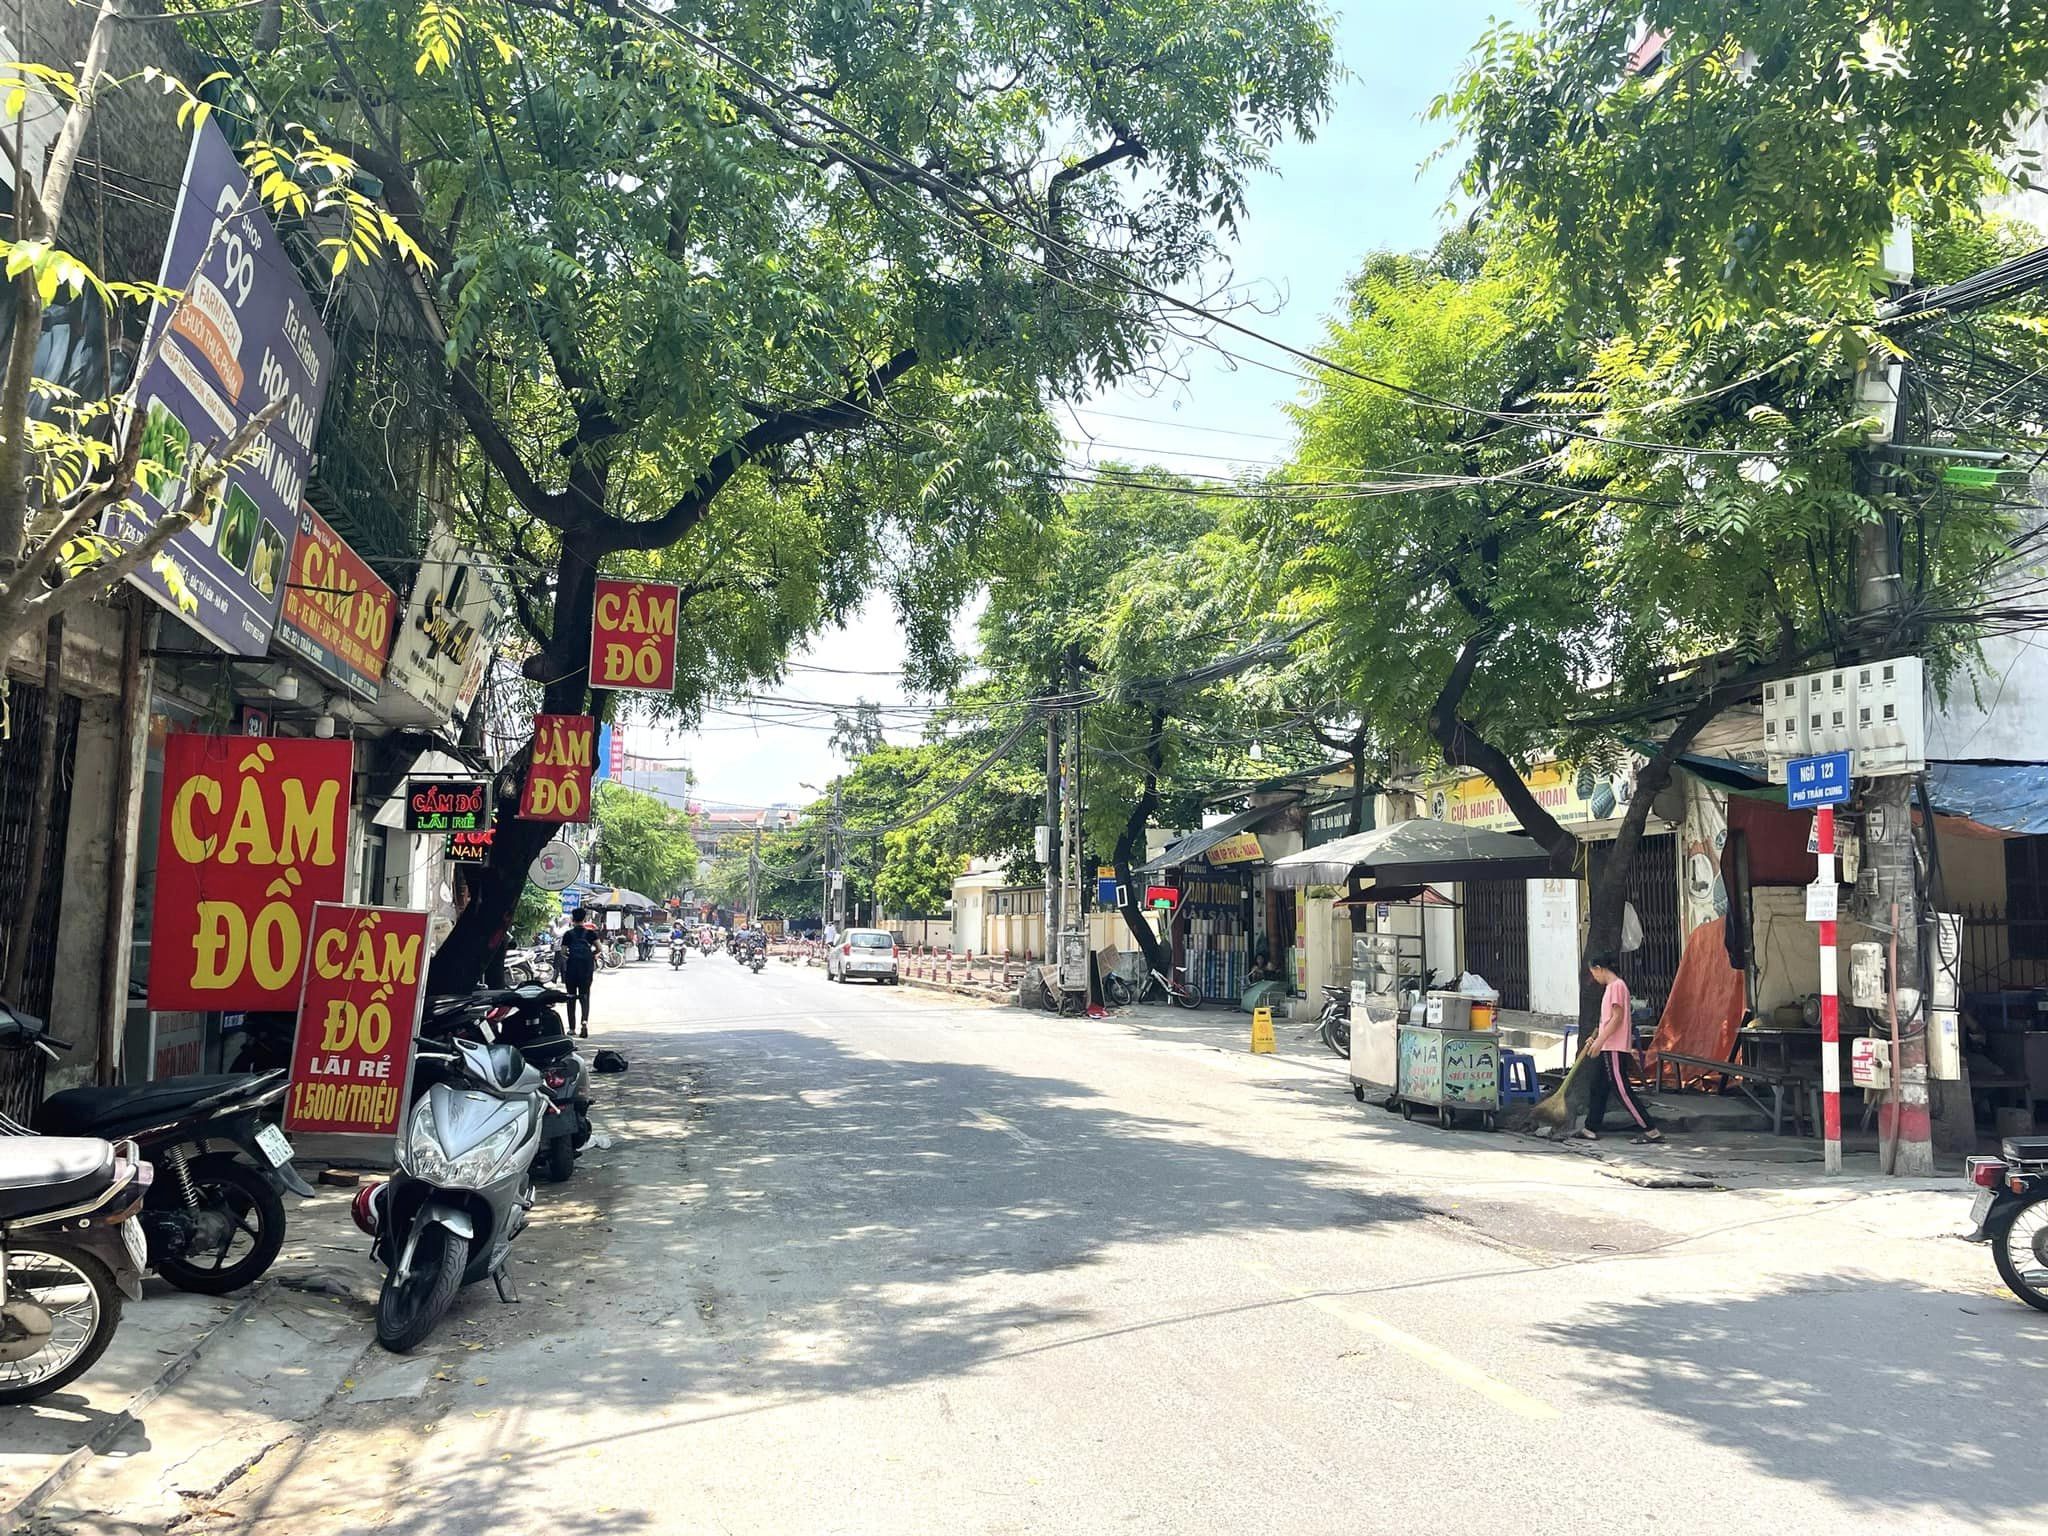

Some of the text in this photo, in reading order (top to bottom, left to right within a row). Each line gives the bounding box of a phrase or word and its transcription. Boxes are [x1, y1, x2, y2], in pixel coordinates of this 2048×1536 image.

[241, 214, 263, 251] SHOP
[198, 283, 239, 349] FARMTECH
[283, 298, 320, 385] Trà Giang
[258, 346, 316, 456] HOA QUẢ
[272, 451, 302, 517] MÙA
[302, 540, 359, 628] CẦM
[355, 588, 392, 651] ĐỒ
[597, 583, 676, 636] CẦM
[603, 634, 663, 684] ĐỒ
[532, 718, 592, 767] CẦM
[530, 769, 582, 817] ĐỒ
[1793, 785, 1843, 801] PHỐ TRẦN CUNG
[1800, 762, 1834, 783] NGÕ 123
[171, 742, 341, 867] CẦM
[417, 812, 448, 829] LÃI
[1451, 801, 1467, 823] CỬA
[1470, 798, 1495, 820] HÀNG
[451, 845, 483, 858] NAM
[190, 867, 303, 992] ĐỒ
[314, 911, 422, 985] CẦM
[320, 983, 395, 1055] ĐỒ
[309, 1053, 393, 1080] LÃI RẺ
[293, 1078, 400, 1131] 1.500đ/TRIỆU
